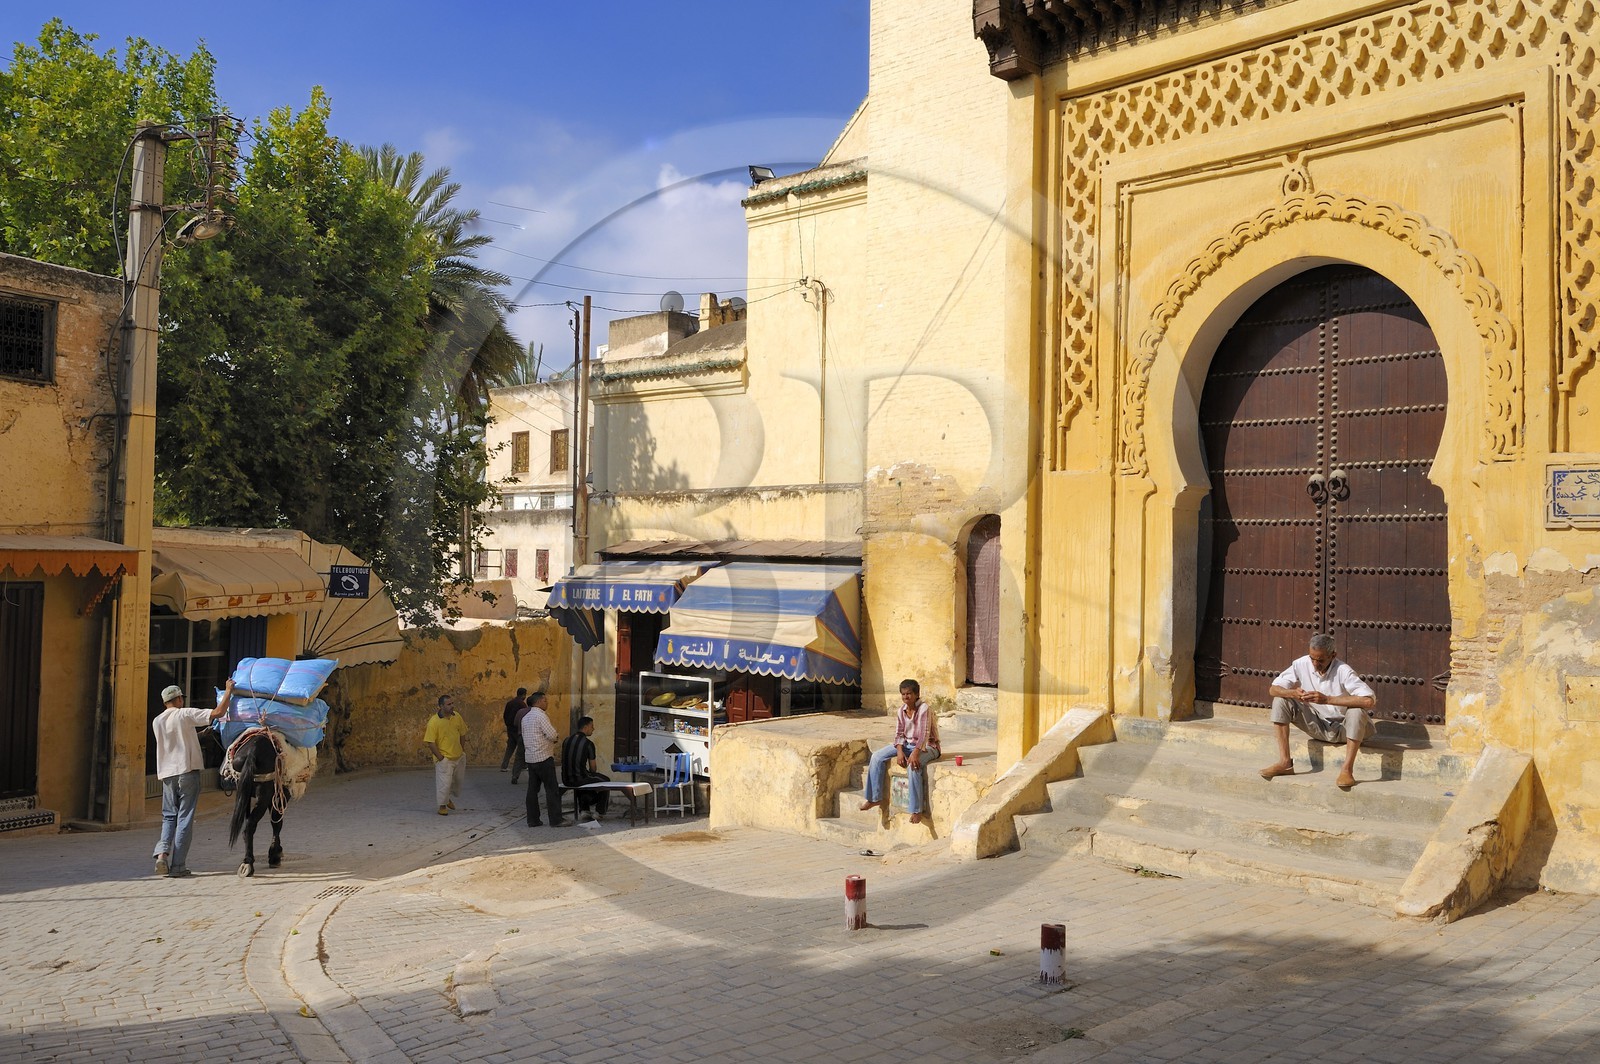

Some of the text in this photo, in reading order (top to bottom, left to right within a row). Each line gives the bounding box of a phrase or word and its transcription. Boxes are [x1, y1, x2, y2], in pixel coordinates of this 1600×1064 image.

[332, 566, 369, 575] TELEBOUTIQUE
[572, 588, 653, 602] LAITIERE EL FATH
[680, 641, 785, 665] محلبة الفتح
